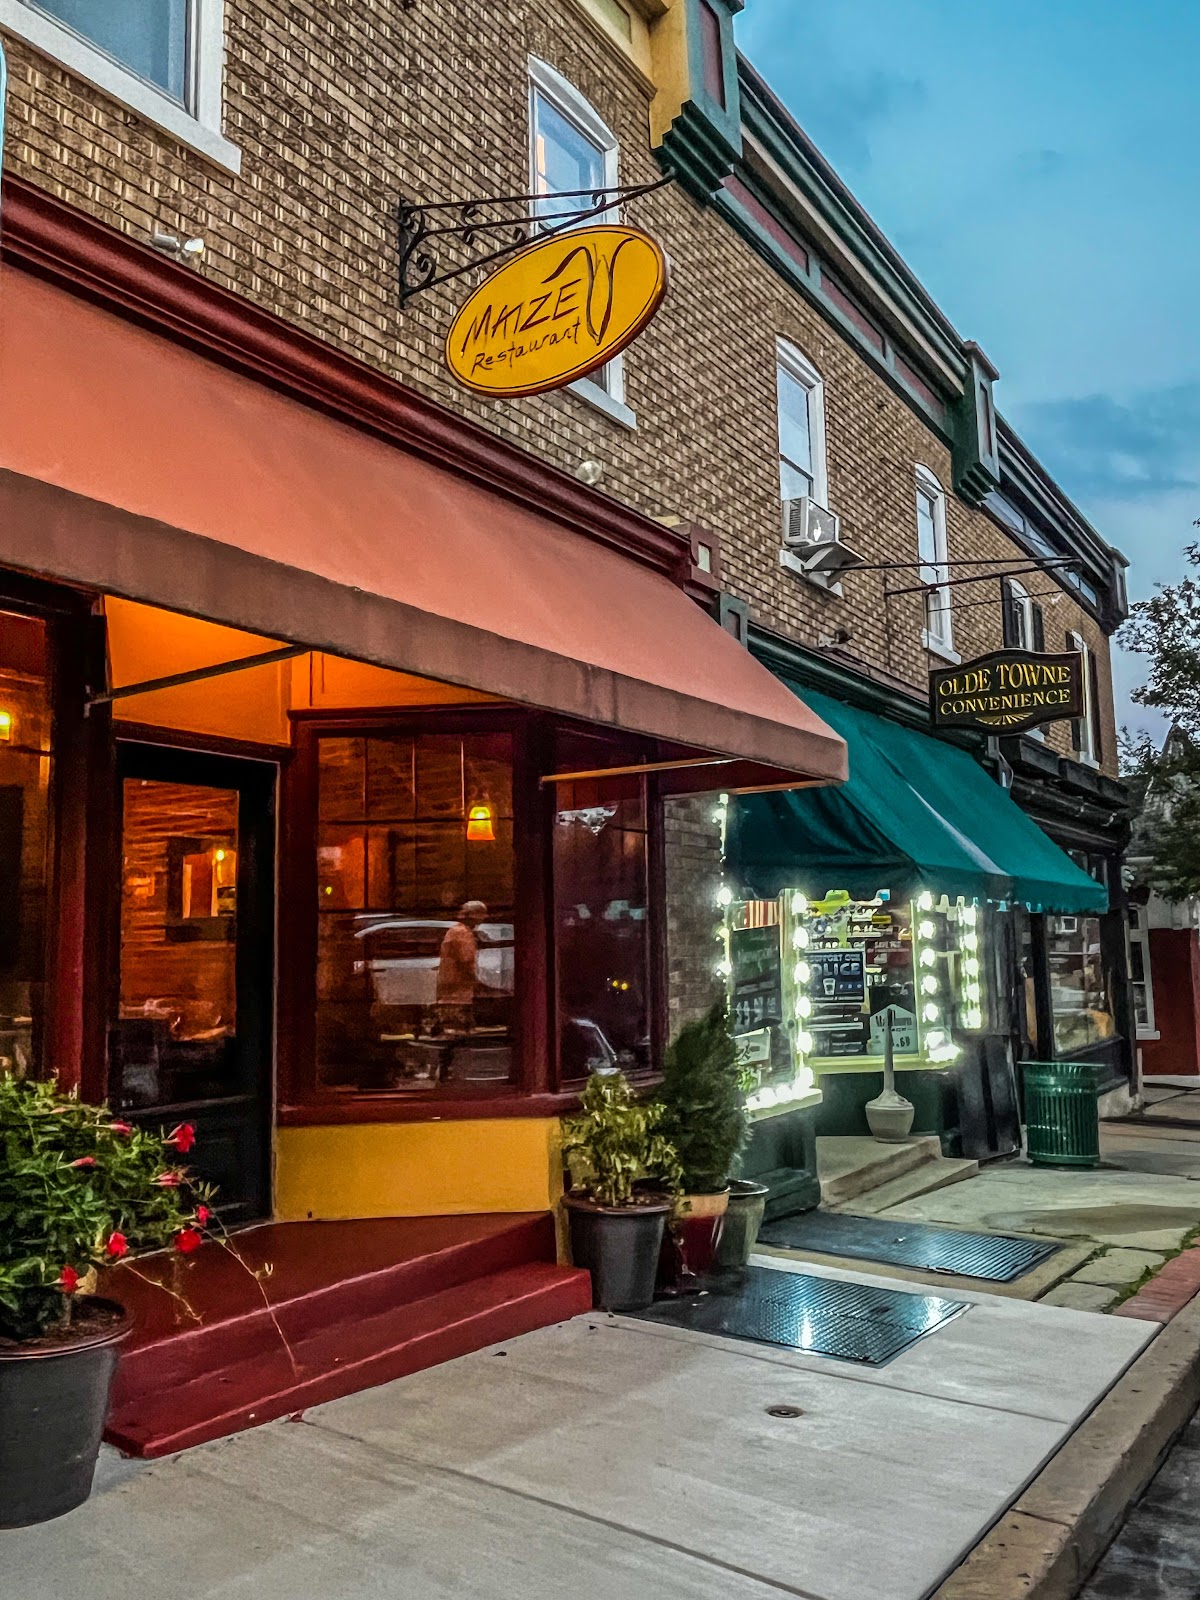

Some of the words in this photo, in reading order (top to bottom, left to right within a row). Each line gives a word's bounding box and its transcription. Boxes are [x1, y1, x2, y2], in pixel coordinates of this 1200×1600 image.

[461, 278, 582, 358] MAIZE
[470, 316, 582, 377] Restaurant
[939, 668, 992, 697] OLDE
[995, 663, 1072, 690] TOWNE
[940, 689, 1071, 716] CONVENIENCE
[807, 962, 861, 976] OLICE
